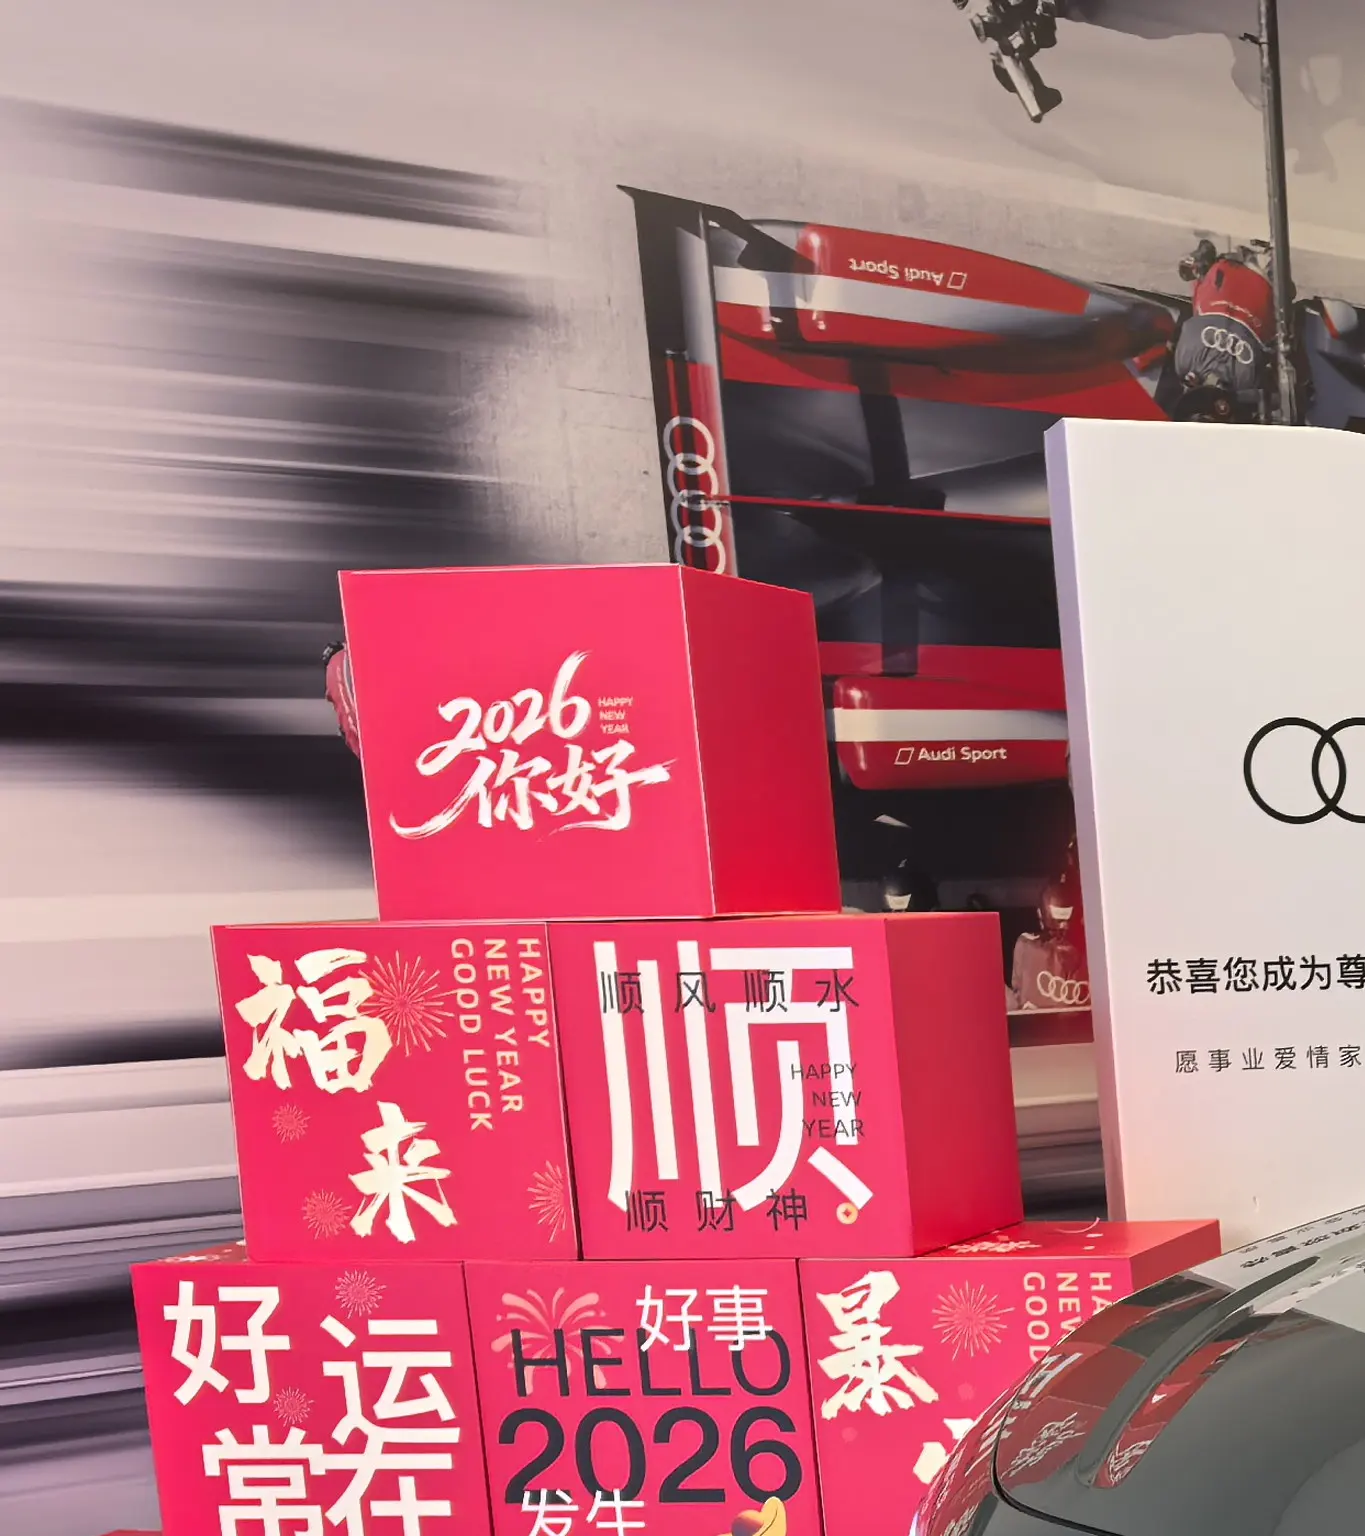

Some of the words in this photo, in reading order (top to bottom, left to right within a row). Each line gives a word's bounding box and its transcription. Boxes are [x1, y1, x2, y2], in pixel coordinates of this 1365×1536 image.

[848, 258, 900, 280] Sport
[904, 267, 944, 286] Audi
[416, 650, 592, 776] 2026
[598, 697, 633, 707] HAPPY
[600, 711, 625, 720] NEW
[601, 723, 630, 734] YEAR
[917, 746, 956, 761] Audi
[960, 746, 1008, 763] Sport
[389, 739, 677, 840] 你好
[451, 938, 482, 1034] GOOD
[484, 939, 514, 1016] NEW
[517, 938, 550, 1048] HAPPY
[600, 969, 860, 1014] 顺风顺水
[462, 1049, 494, 1131] LUCK
[495, 1028, 524, 1113] YEAR
[594, 940, 873, 1212] 顺
[791, 1063, 857, 1080] HAPPY
[812, 1091, 861, 1107] NEW
[802, 1119, 864, 1138] YEAR
[625, 1188, 808, 1232] 顺财神
[636, 1284, 773, 1352] 好事
[511, 1328, 791, 1397] HELLO
[498, 1406, 803, 1504] 2026
